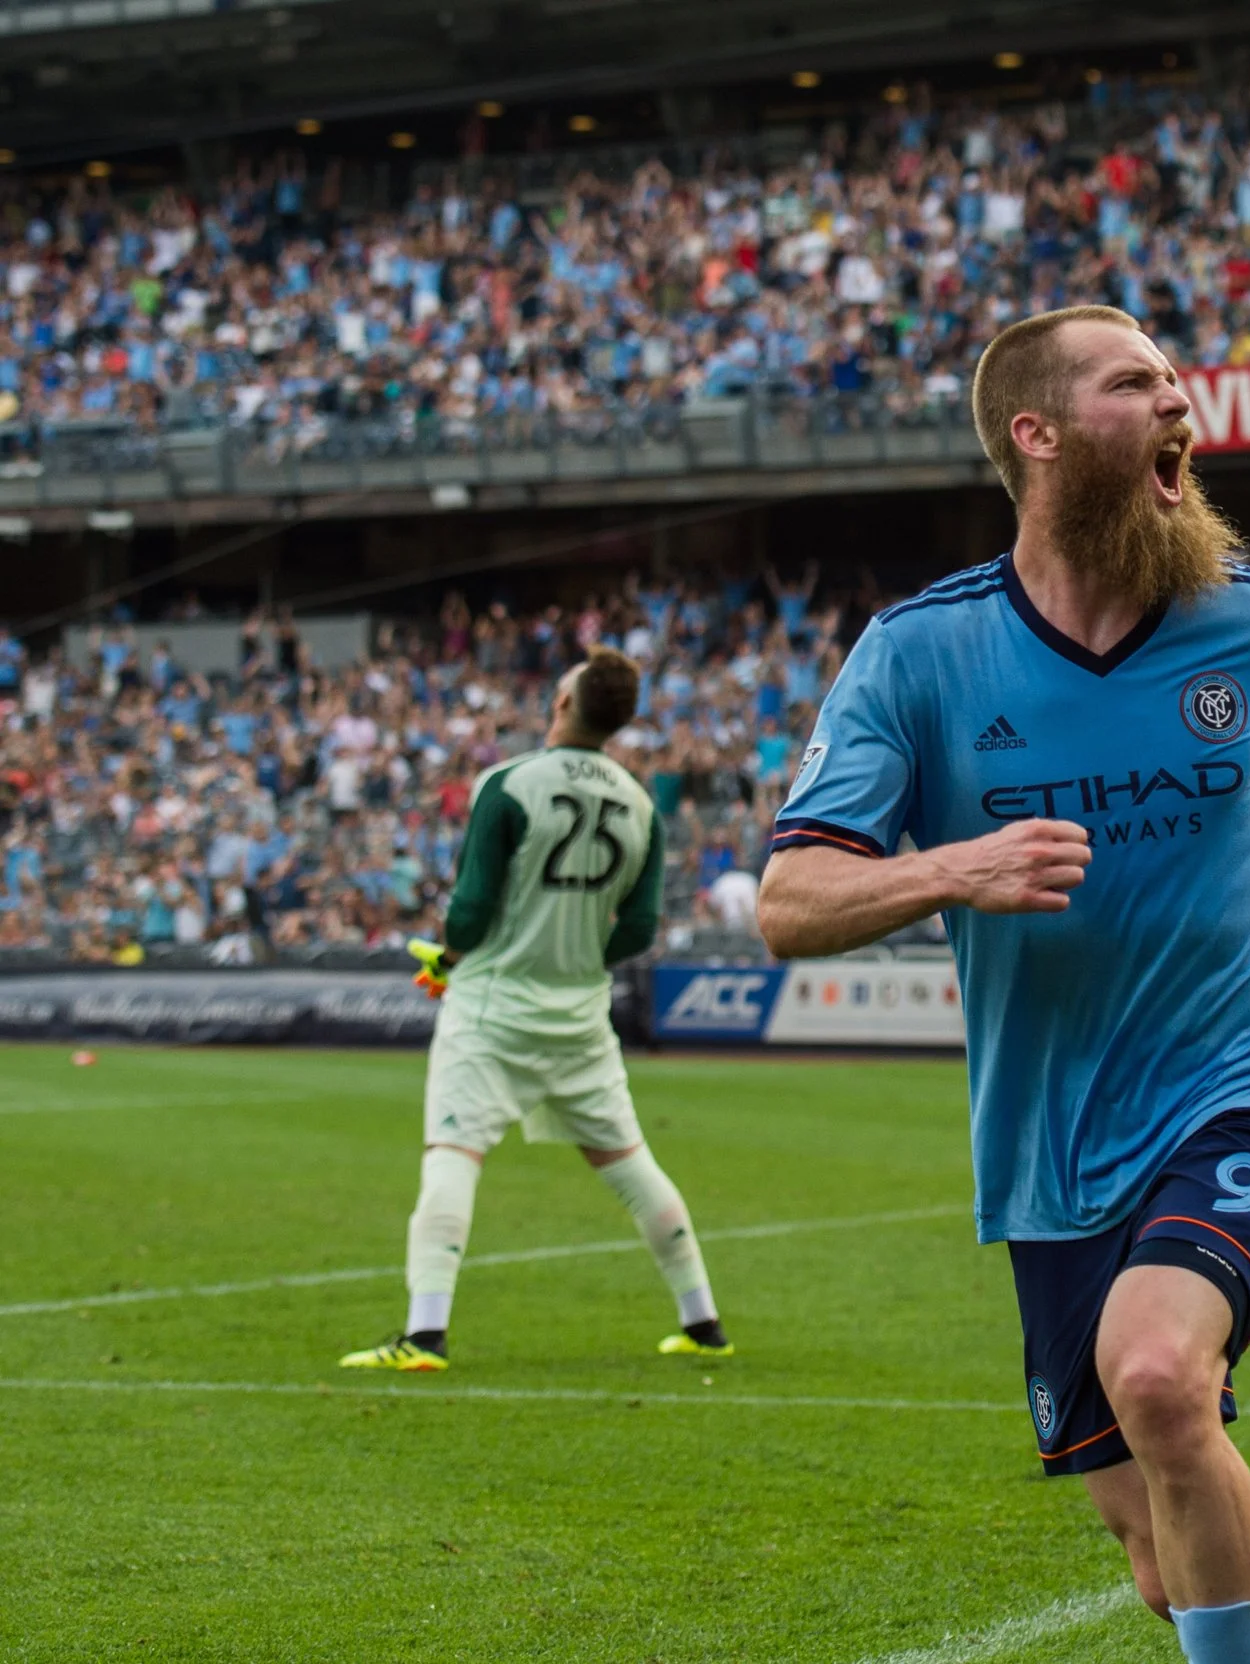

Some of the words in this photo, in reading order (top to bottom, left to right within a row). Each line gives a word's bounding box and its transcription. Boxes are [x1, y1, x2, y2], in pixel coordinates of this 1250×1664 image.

[974, 737, 1028, 752] adidas
[981, 760, 1244, 820] ETIHAD
[543, 793, 629, 889] 25
[1086, 812, 1203, 849] RWAYS
[664, 974, 766, 1028] ACC
